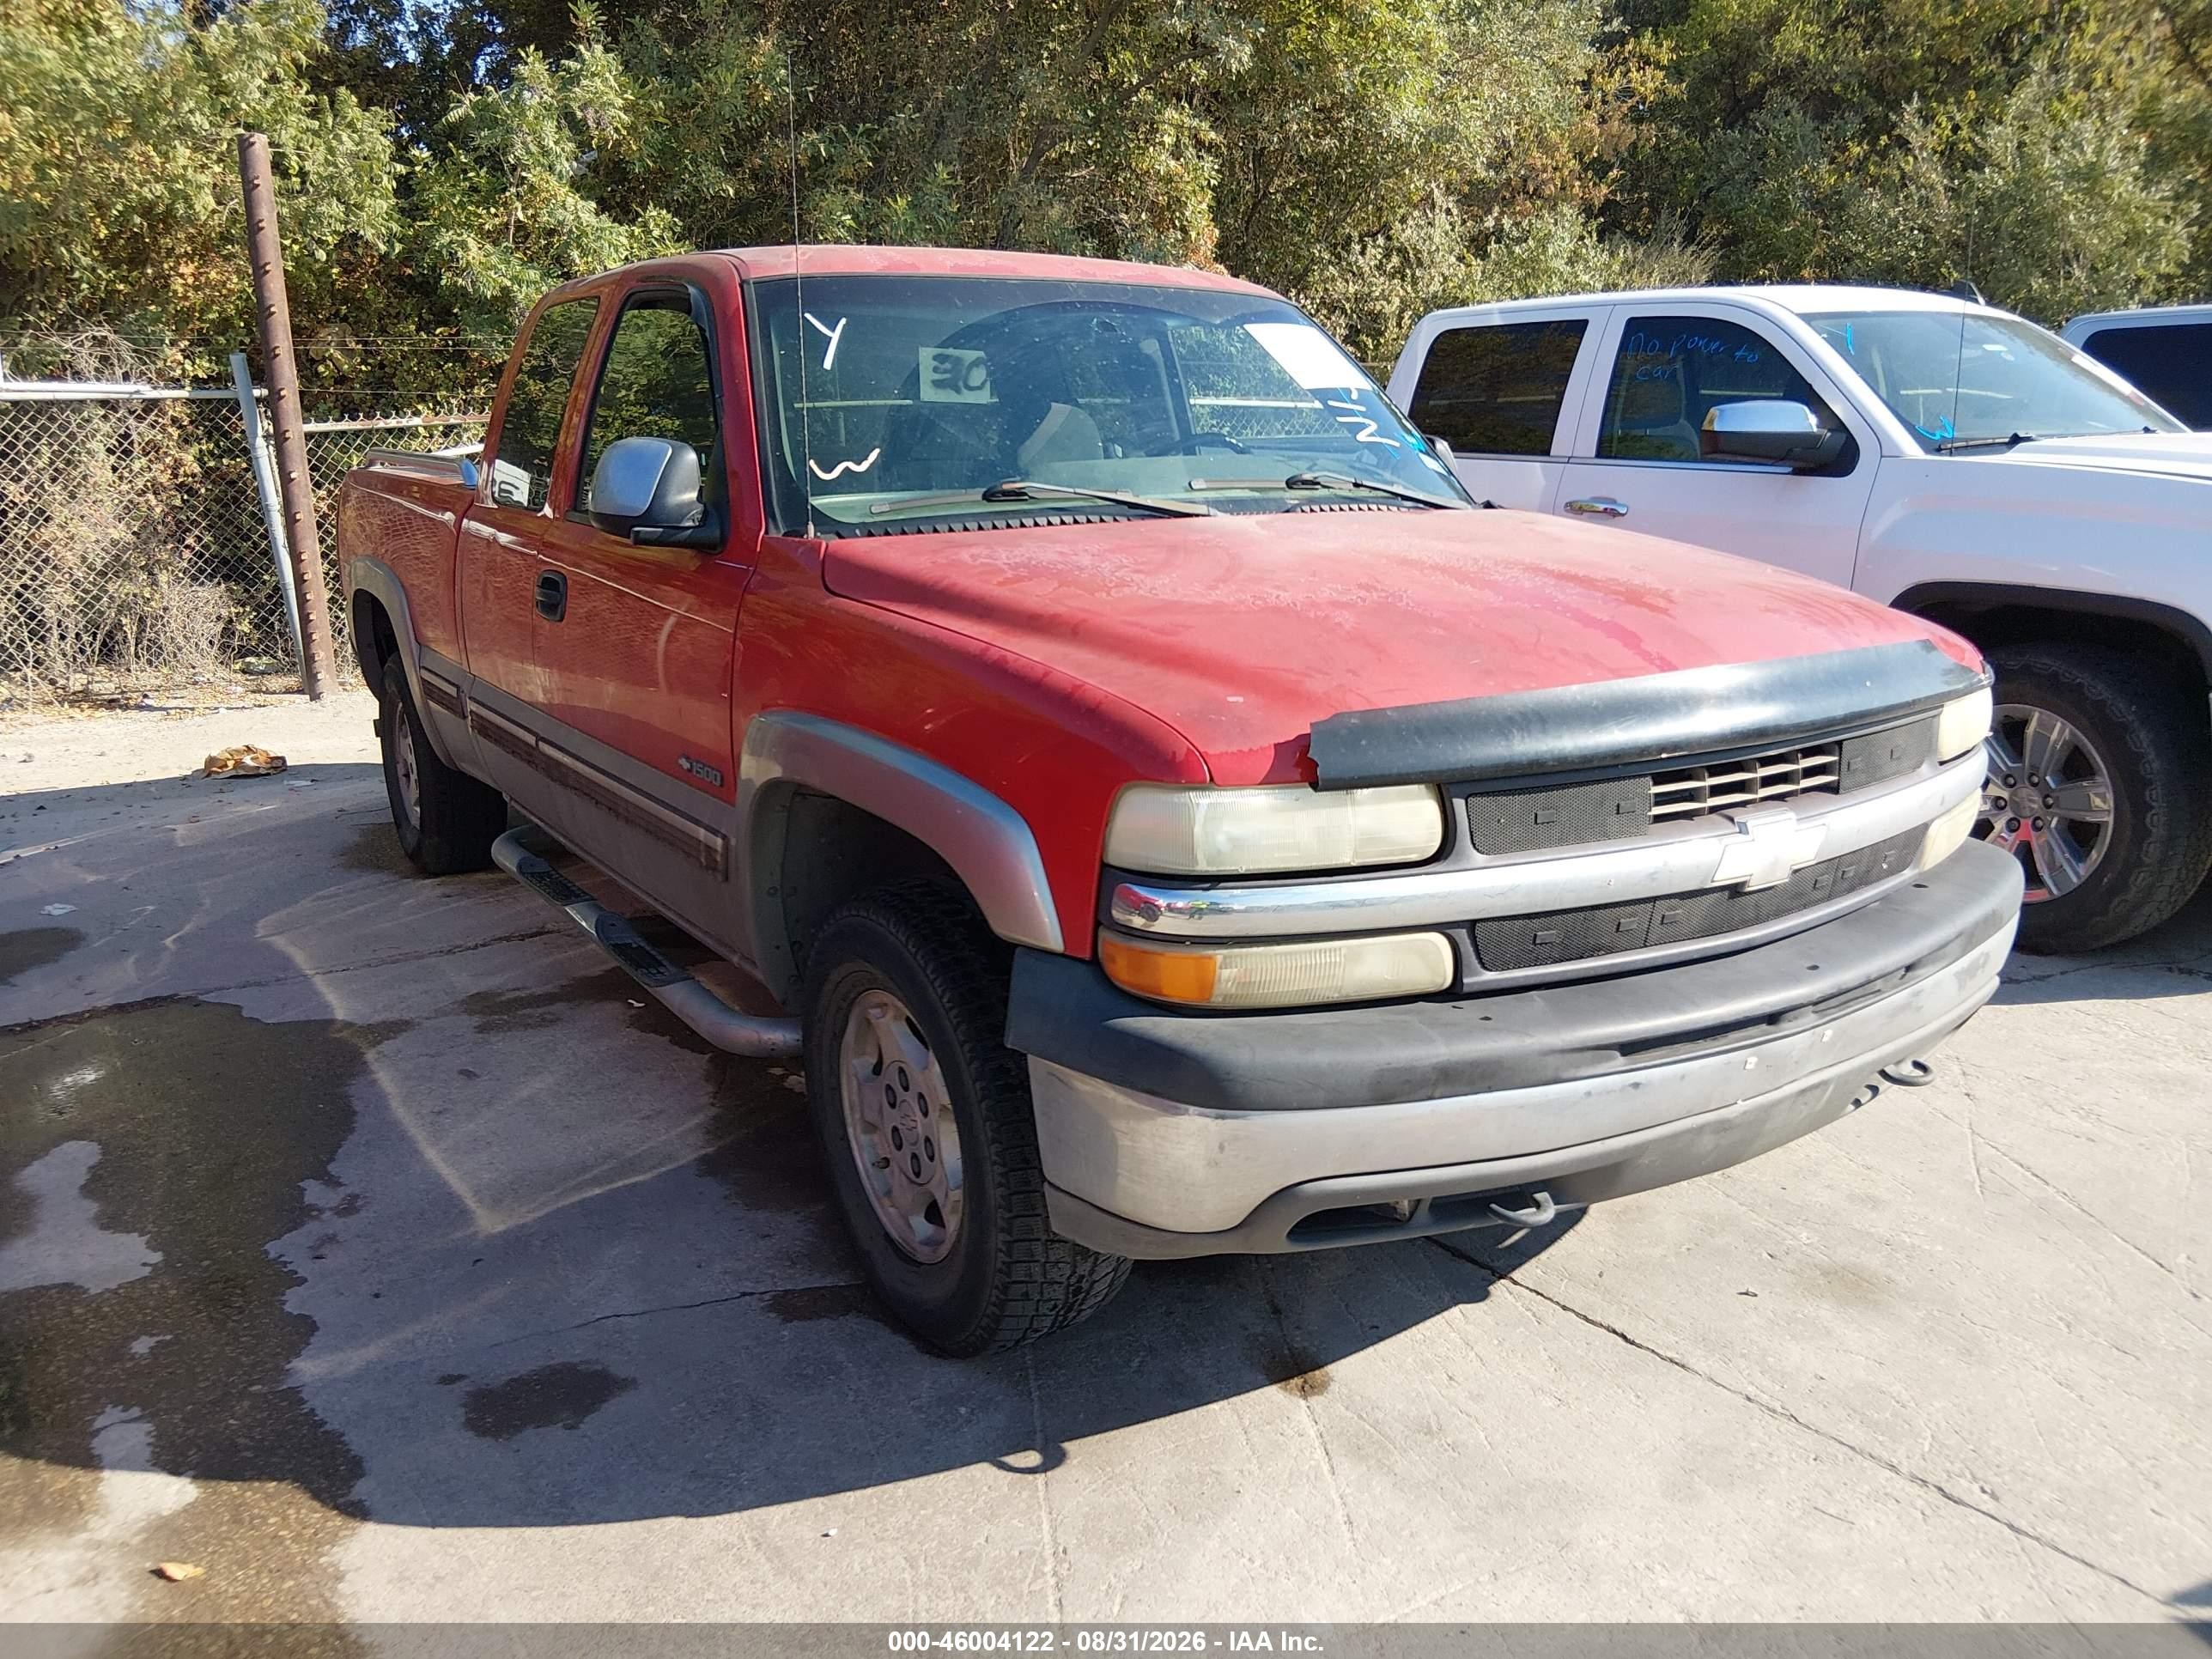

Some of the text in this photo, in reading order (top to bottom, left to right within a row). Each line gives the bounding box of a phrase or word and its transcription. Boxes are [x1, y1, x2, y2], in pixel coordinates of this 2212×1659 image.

[804, 312, 848, 370] Y
[1669, 334, 1729, 358] power
[1733, 343, 1759, 363] to
[1636, 363, 1680, 380] car
[692, 762, 721, 786] 1500
